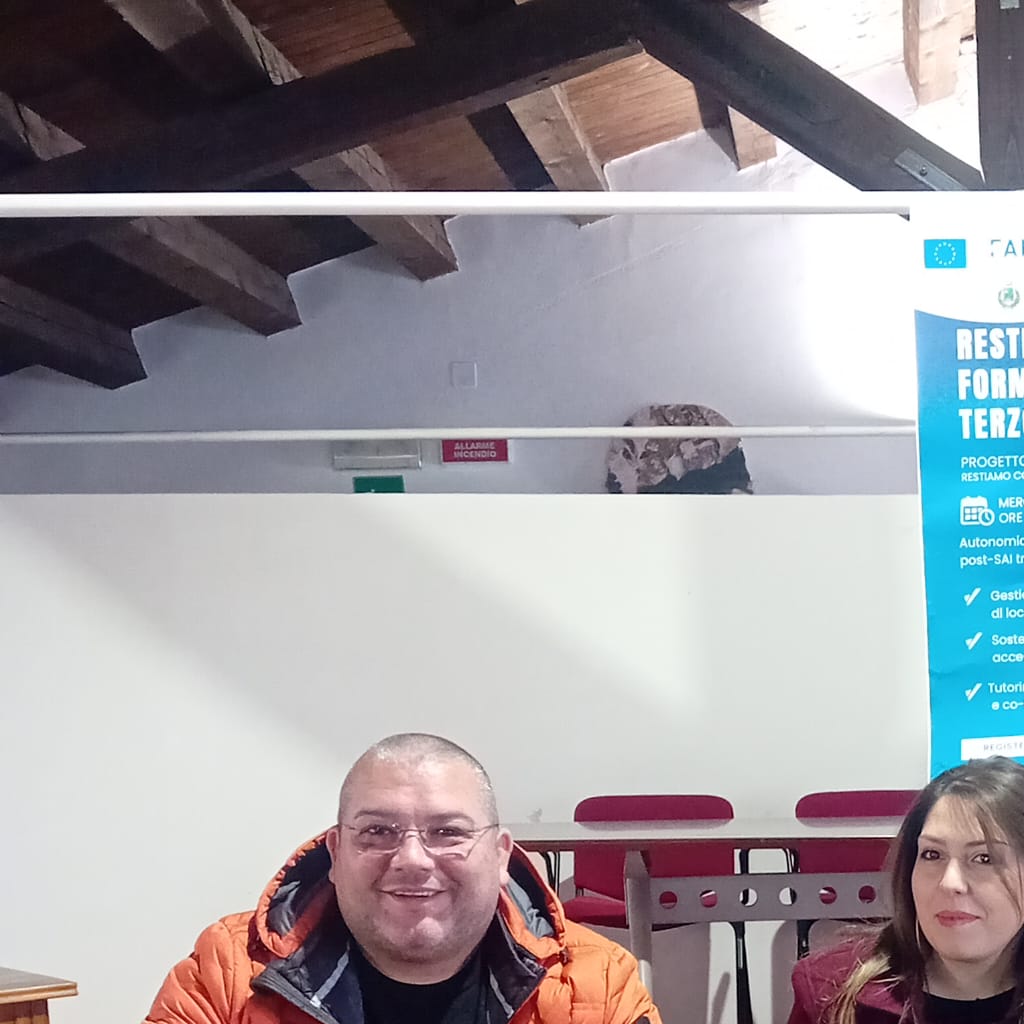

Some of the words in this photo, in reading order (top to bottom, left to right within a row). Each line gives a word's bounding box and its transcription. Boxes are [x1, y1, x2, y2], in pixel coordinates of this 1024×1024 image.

[454, 442, 495, 450] ALLARME
[961, 471, 1010, 482] RESTIAMO
[999, 512, 1023, 524] ORE
[960, 553, 1013, 569] post-SAI
[991, 606, 1003, 619] di
[991, 701, 1000, 710] e
